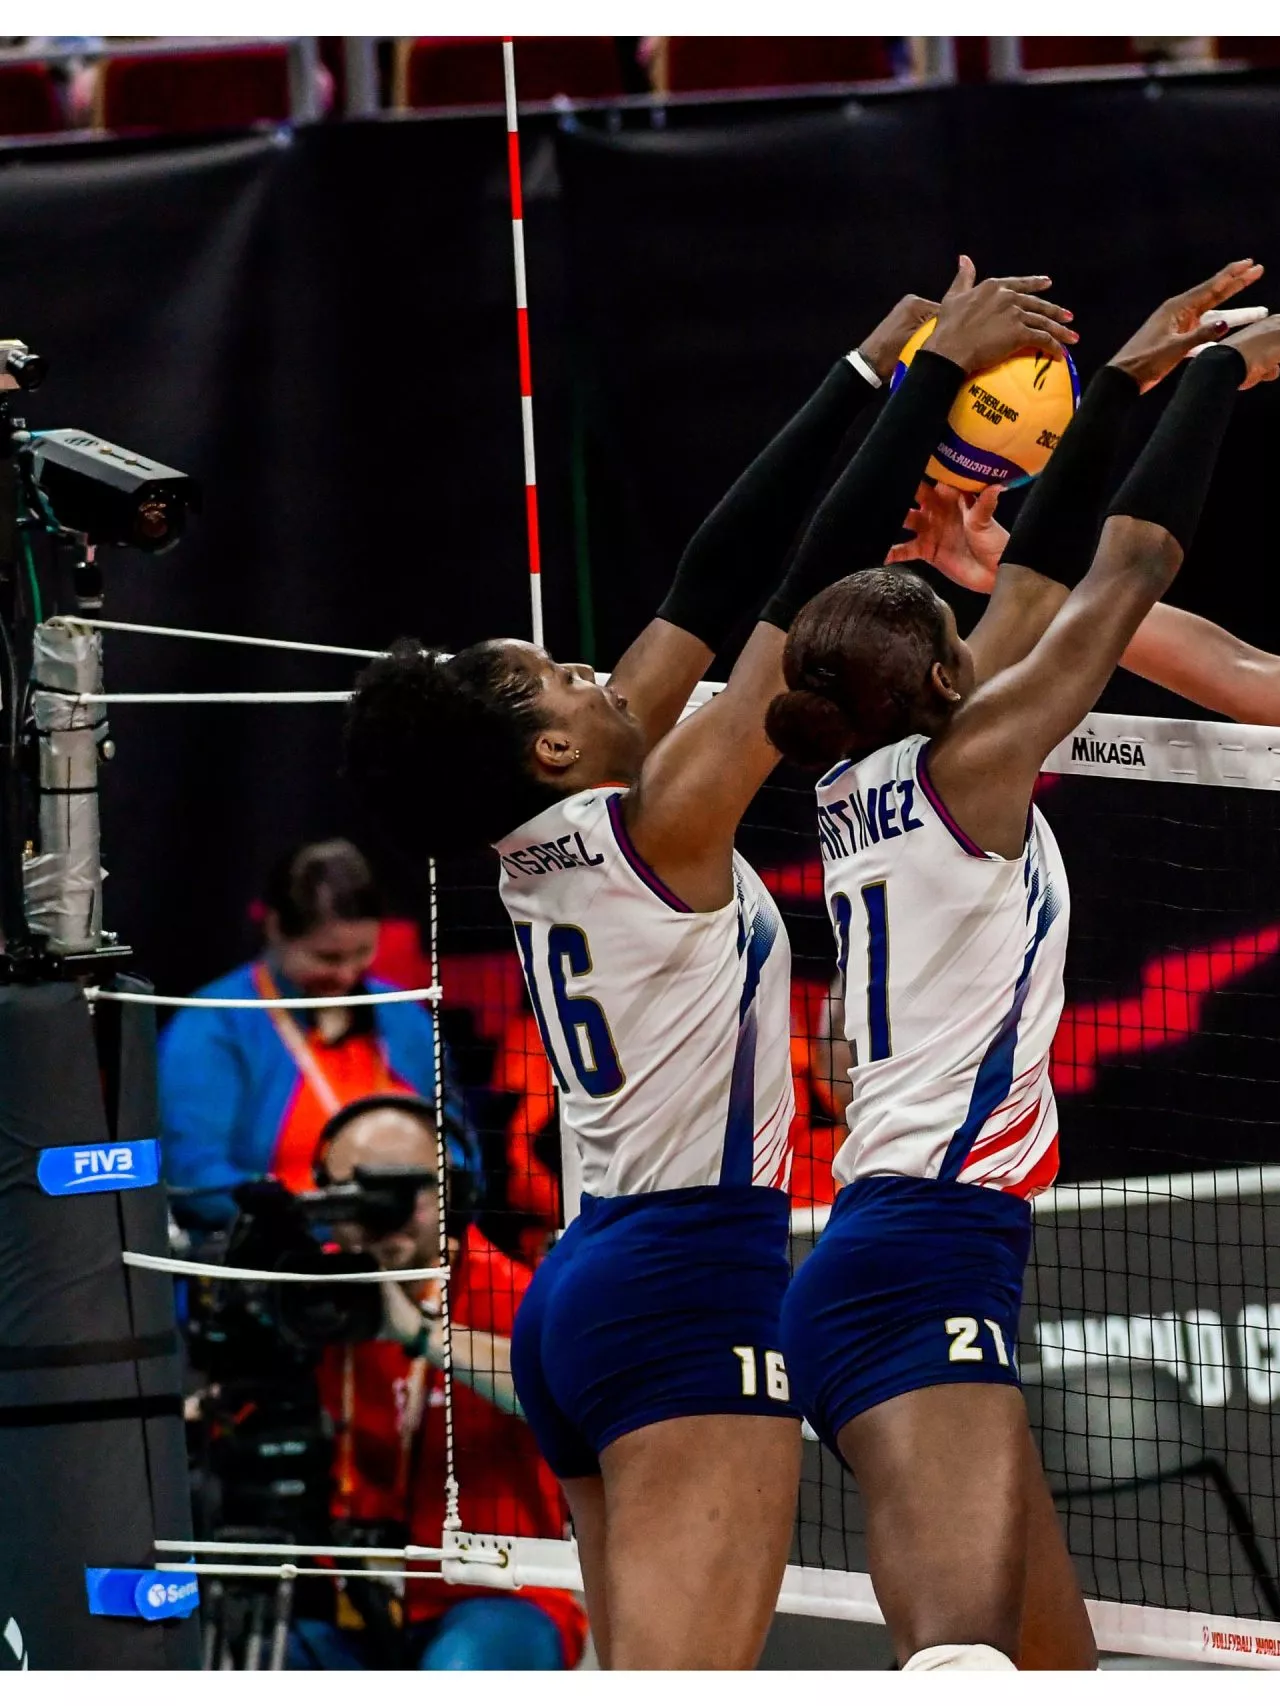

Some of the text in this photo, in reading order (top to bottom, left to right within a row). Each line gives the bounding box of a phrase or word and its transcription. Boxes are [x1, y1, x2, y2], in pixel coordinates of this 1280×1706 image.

[968, 384, 1019, 422] NETHERLANDS
[972, 400, 1002, 425] POLAND
[1071, 736, 1146, 767] MIKASA
[515, 921, 626, 1098] 16
[73, 1147, 133, 1175] FIVB
[945, 1317, 1010, 1367] 21
[733, 1345, 790, 1402] 16
